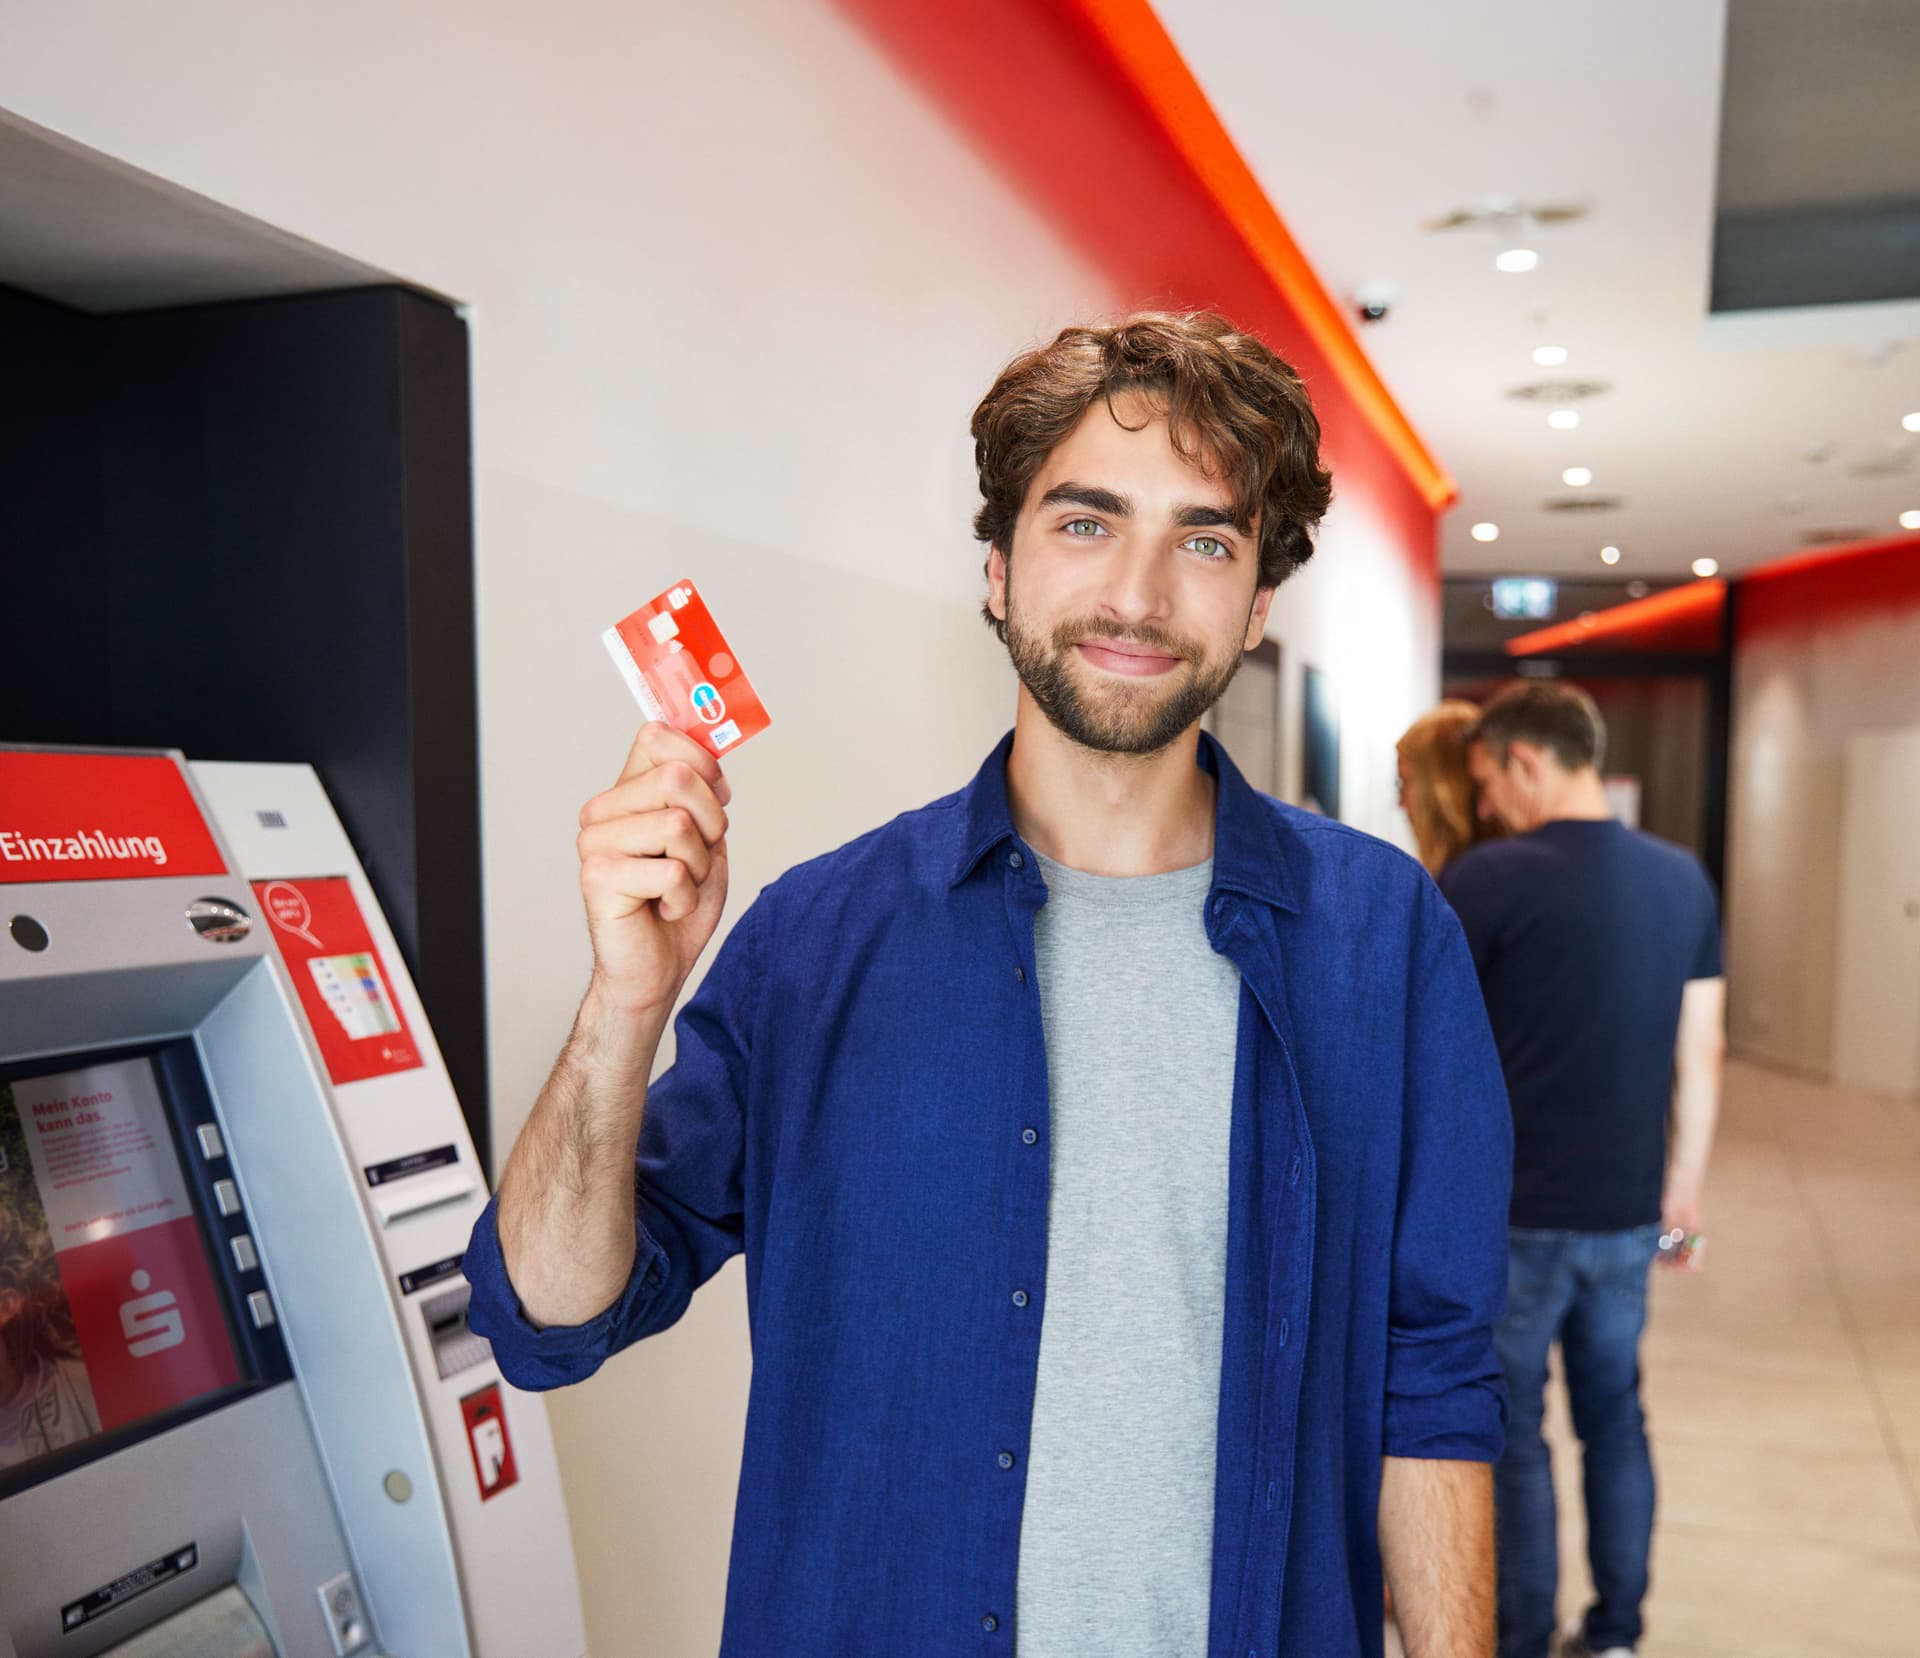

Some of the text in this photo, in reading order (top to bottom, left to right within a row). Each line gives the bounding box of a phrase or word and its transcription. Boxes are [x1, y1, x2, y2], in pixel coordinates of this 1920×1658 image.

[0, 830, 167, 864] Einzahlung
[32, 1092, 113, 1118] Mein Konto
[36, 1115, 73, 1135] kann
